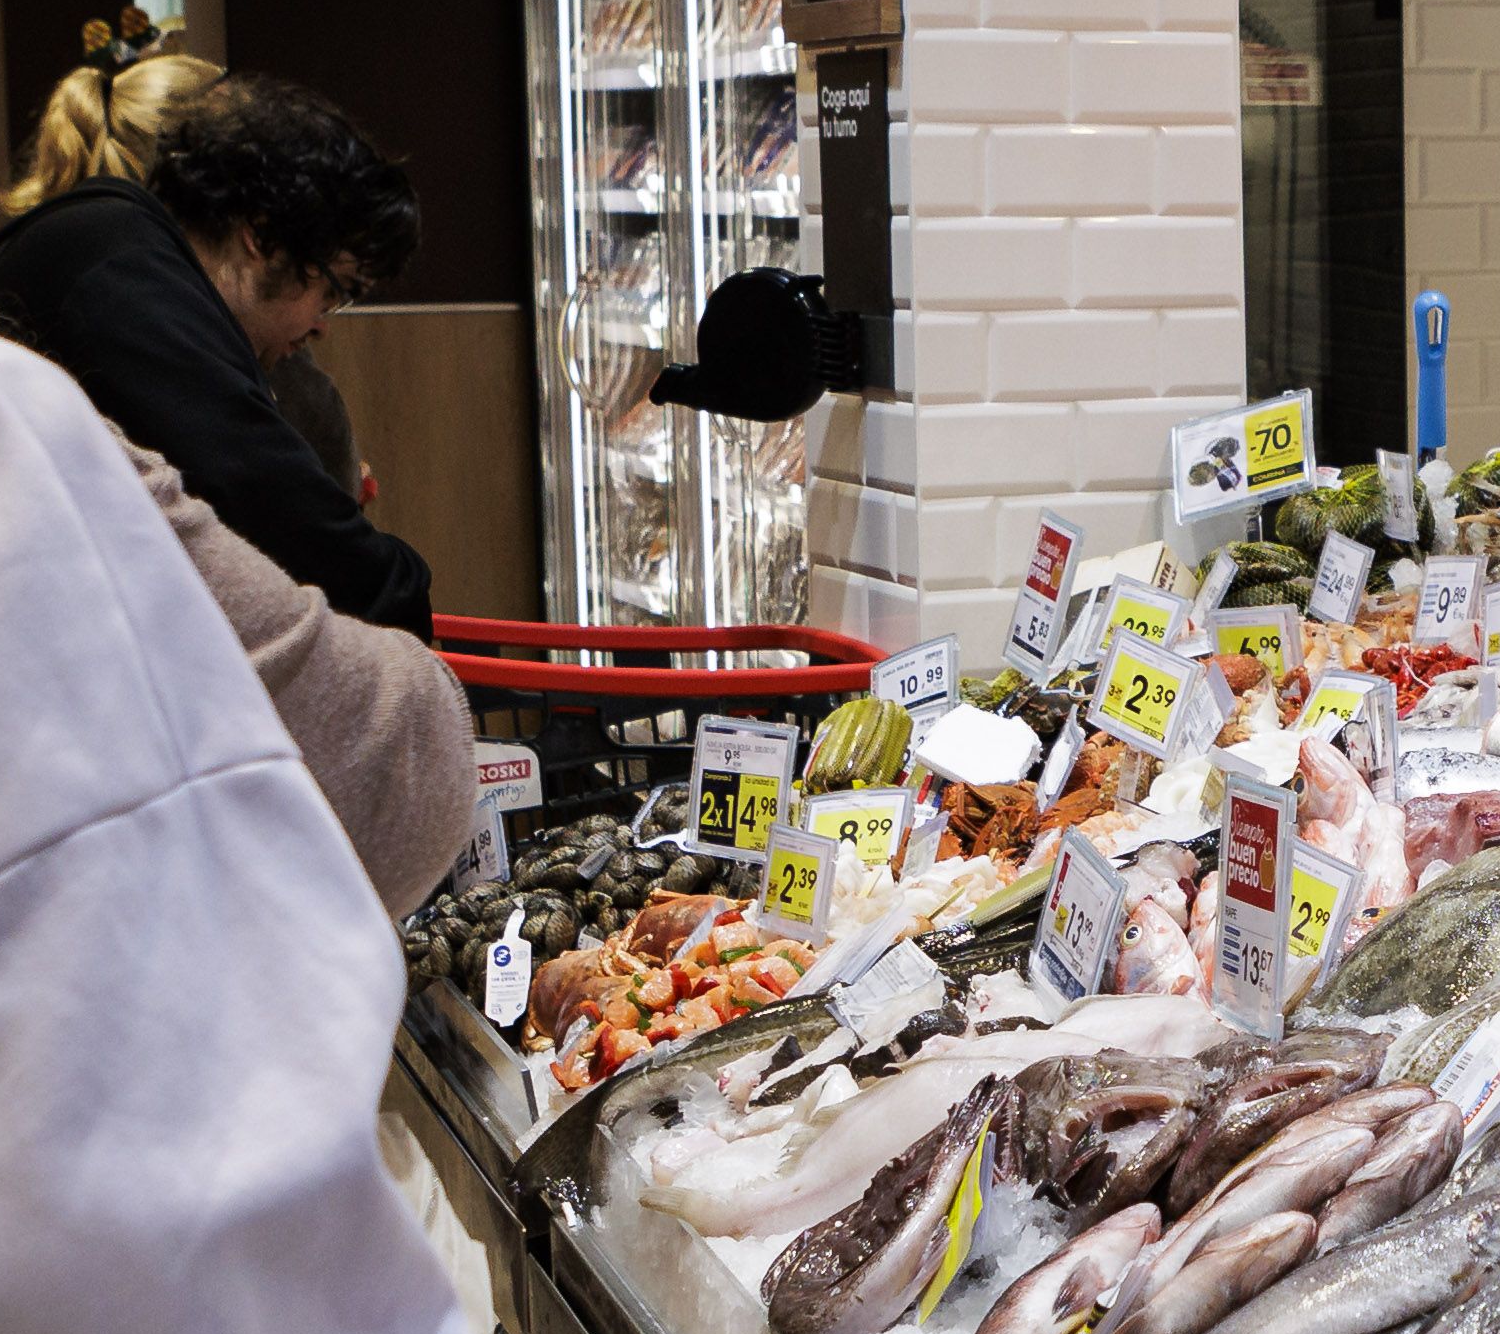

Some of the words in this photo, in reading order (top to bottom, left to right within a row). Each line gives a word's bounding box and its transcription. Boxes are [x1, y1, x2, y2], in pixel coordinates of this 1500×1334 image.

[822, 85, 846, 114] Coge
[849, 81, 870, 111] aquí
[823, 116, 832, 139] tu
[833, 116, 858, 137] turno
[1436, 586, 1467, 624] 9,89
[899, 666, 943, 698] 10,99
[1124, 675, 1176, 714] 2,39
[700, 792, 735, 829] 2x1
[739, 796, 778, 833] 4,98
[840, 818, 893, 847] 8,99
[1229, 840, 1256, 866] buen
[780, 864, 818, 904] 2,39
[1227, 863, 1260, 888] precio
